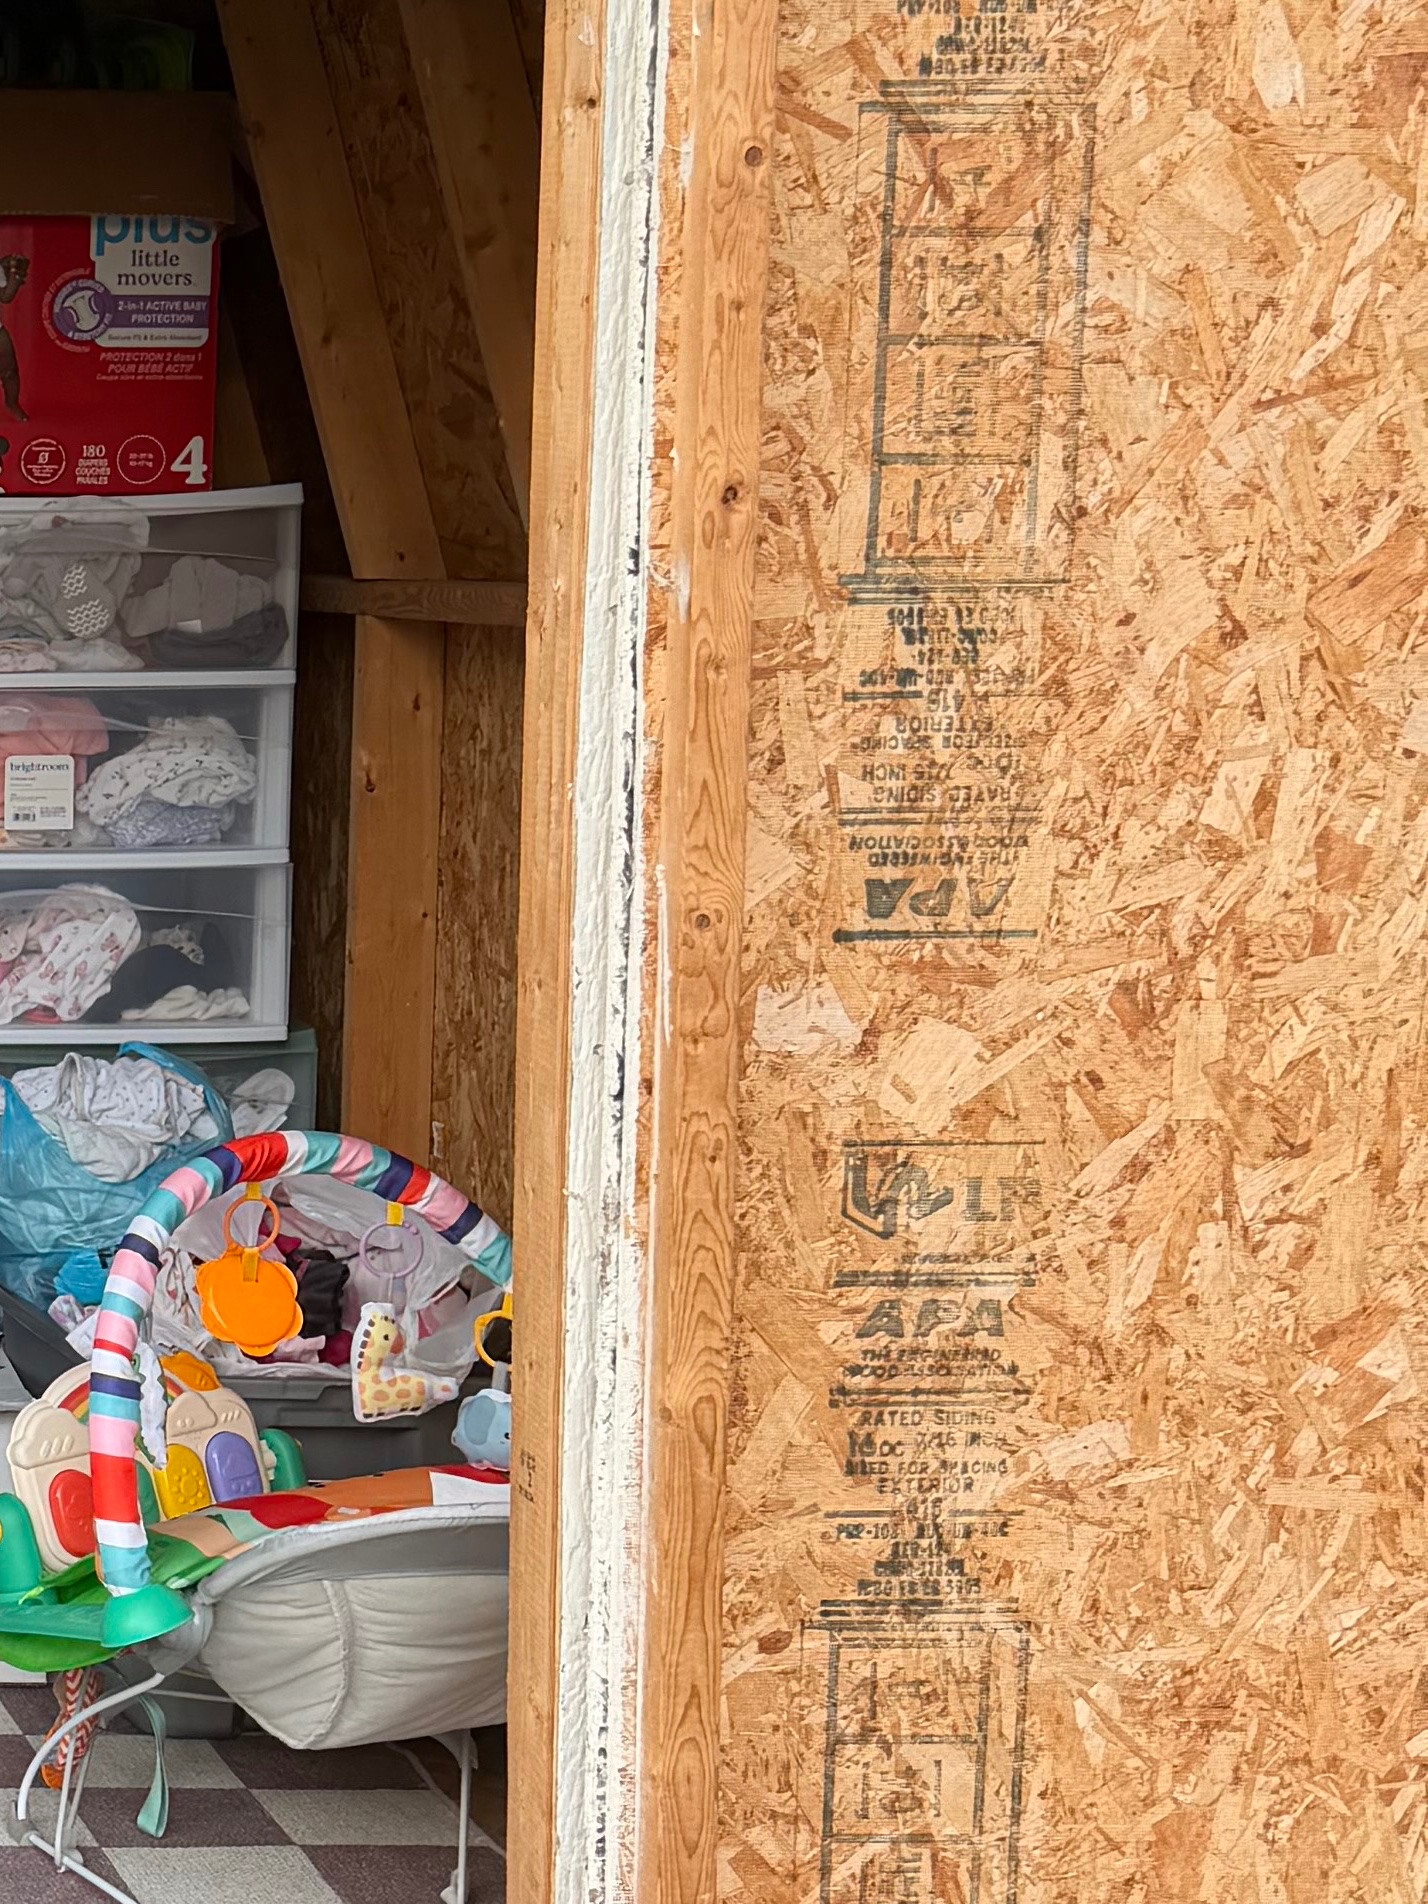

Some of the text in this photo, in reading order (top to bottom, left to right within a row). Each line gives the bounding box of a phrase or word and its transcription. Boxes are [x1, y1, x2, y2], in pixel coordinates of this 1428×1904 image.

[131, 249, 180, 268] little
[117, 272, 193, 286] movers
[145, 300, 182, 311] ACTIVE
[182, 300, 208, 311] BABY
[130, 313, 194, 324] PROTECTION
[99, 352, 164, 362] PROTECTION
[107, 364, 136, 374] POUR
[81, 444, 106, 458] 180
[170, 435, 209, 485] 4
[864, 877, 1016, 921] APA
[854, 1298, 1005, 1338] APA
[858, 1409, 997, 1427] RATED SIDING
[897, 1460, 930, 1476] FOR
[876, 1476, 975, 1495] EXTERIOR
